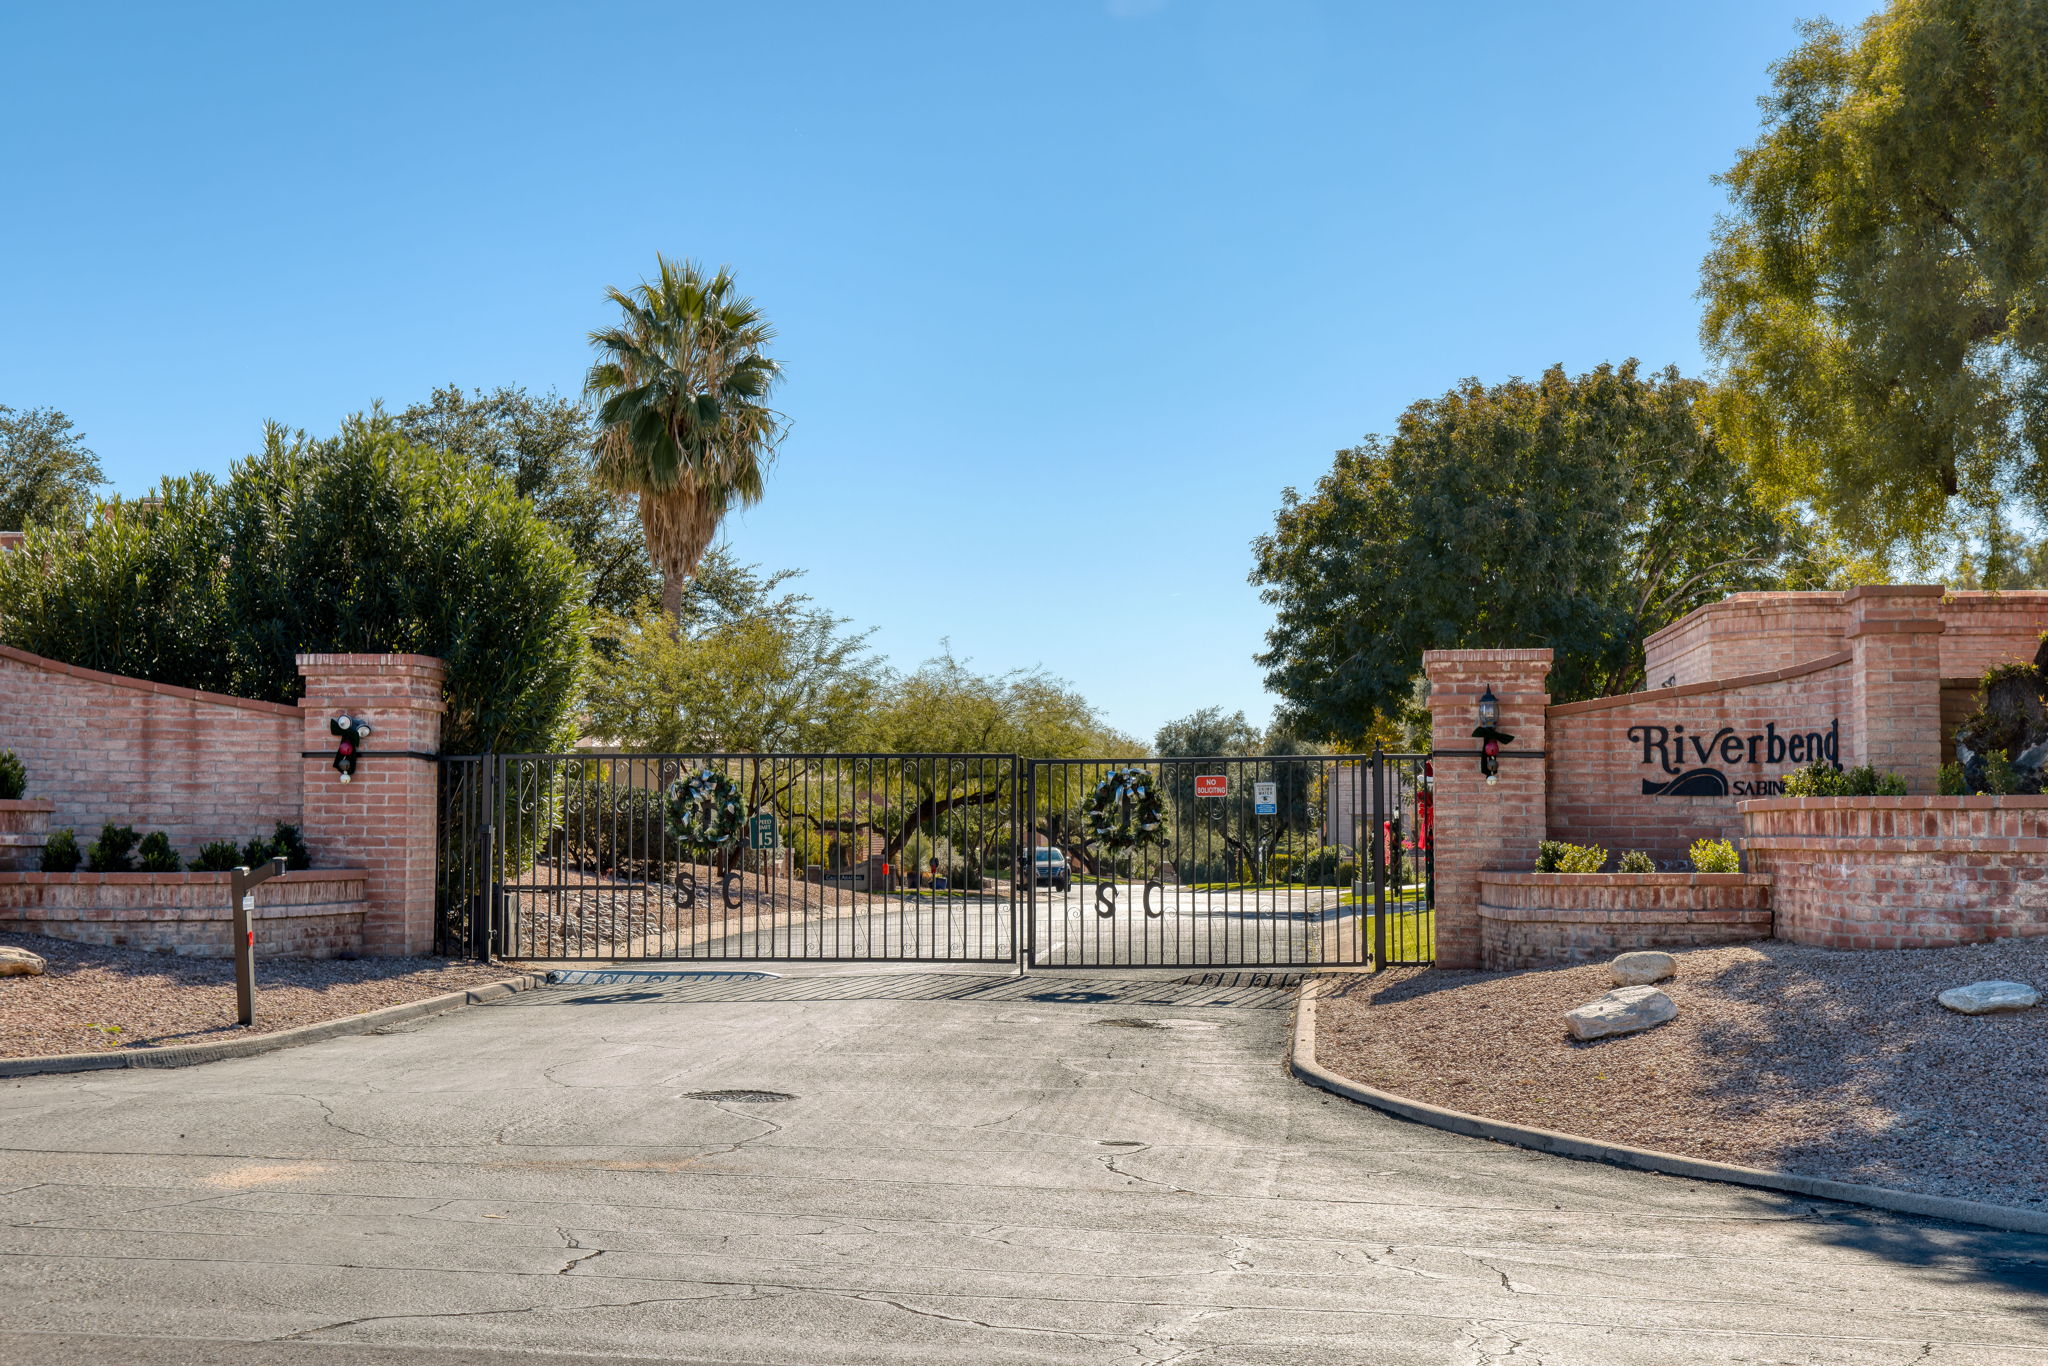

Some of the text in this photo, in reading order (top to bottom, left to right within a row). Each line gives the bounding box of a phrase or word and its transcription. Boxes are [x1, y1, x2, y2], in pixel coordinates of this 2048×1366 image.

[1627, 717, 1844, 775] Riverbend
[1197, 786, 1226, 794] SOLICITING
[1206, 778, 1217, 786] NO
[1732, 780, 1788, 797] SABIN
[757, 831, 773, 846] 15
[674, 872, 743, 909] S C
[1094, 880, 1165, 919] S C
